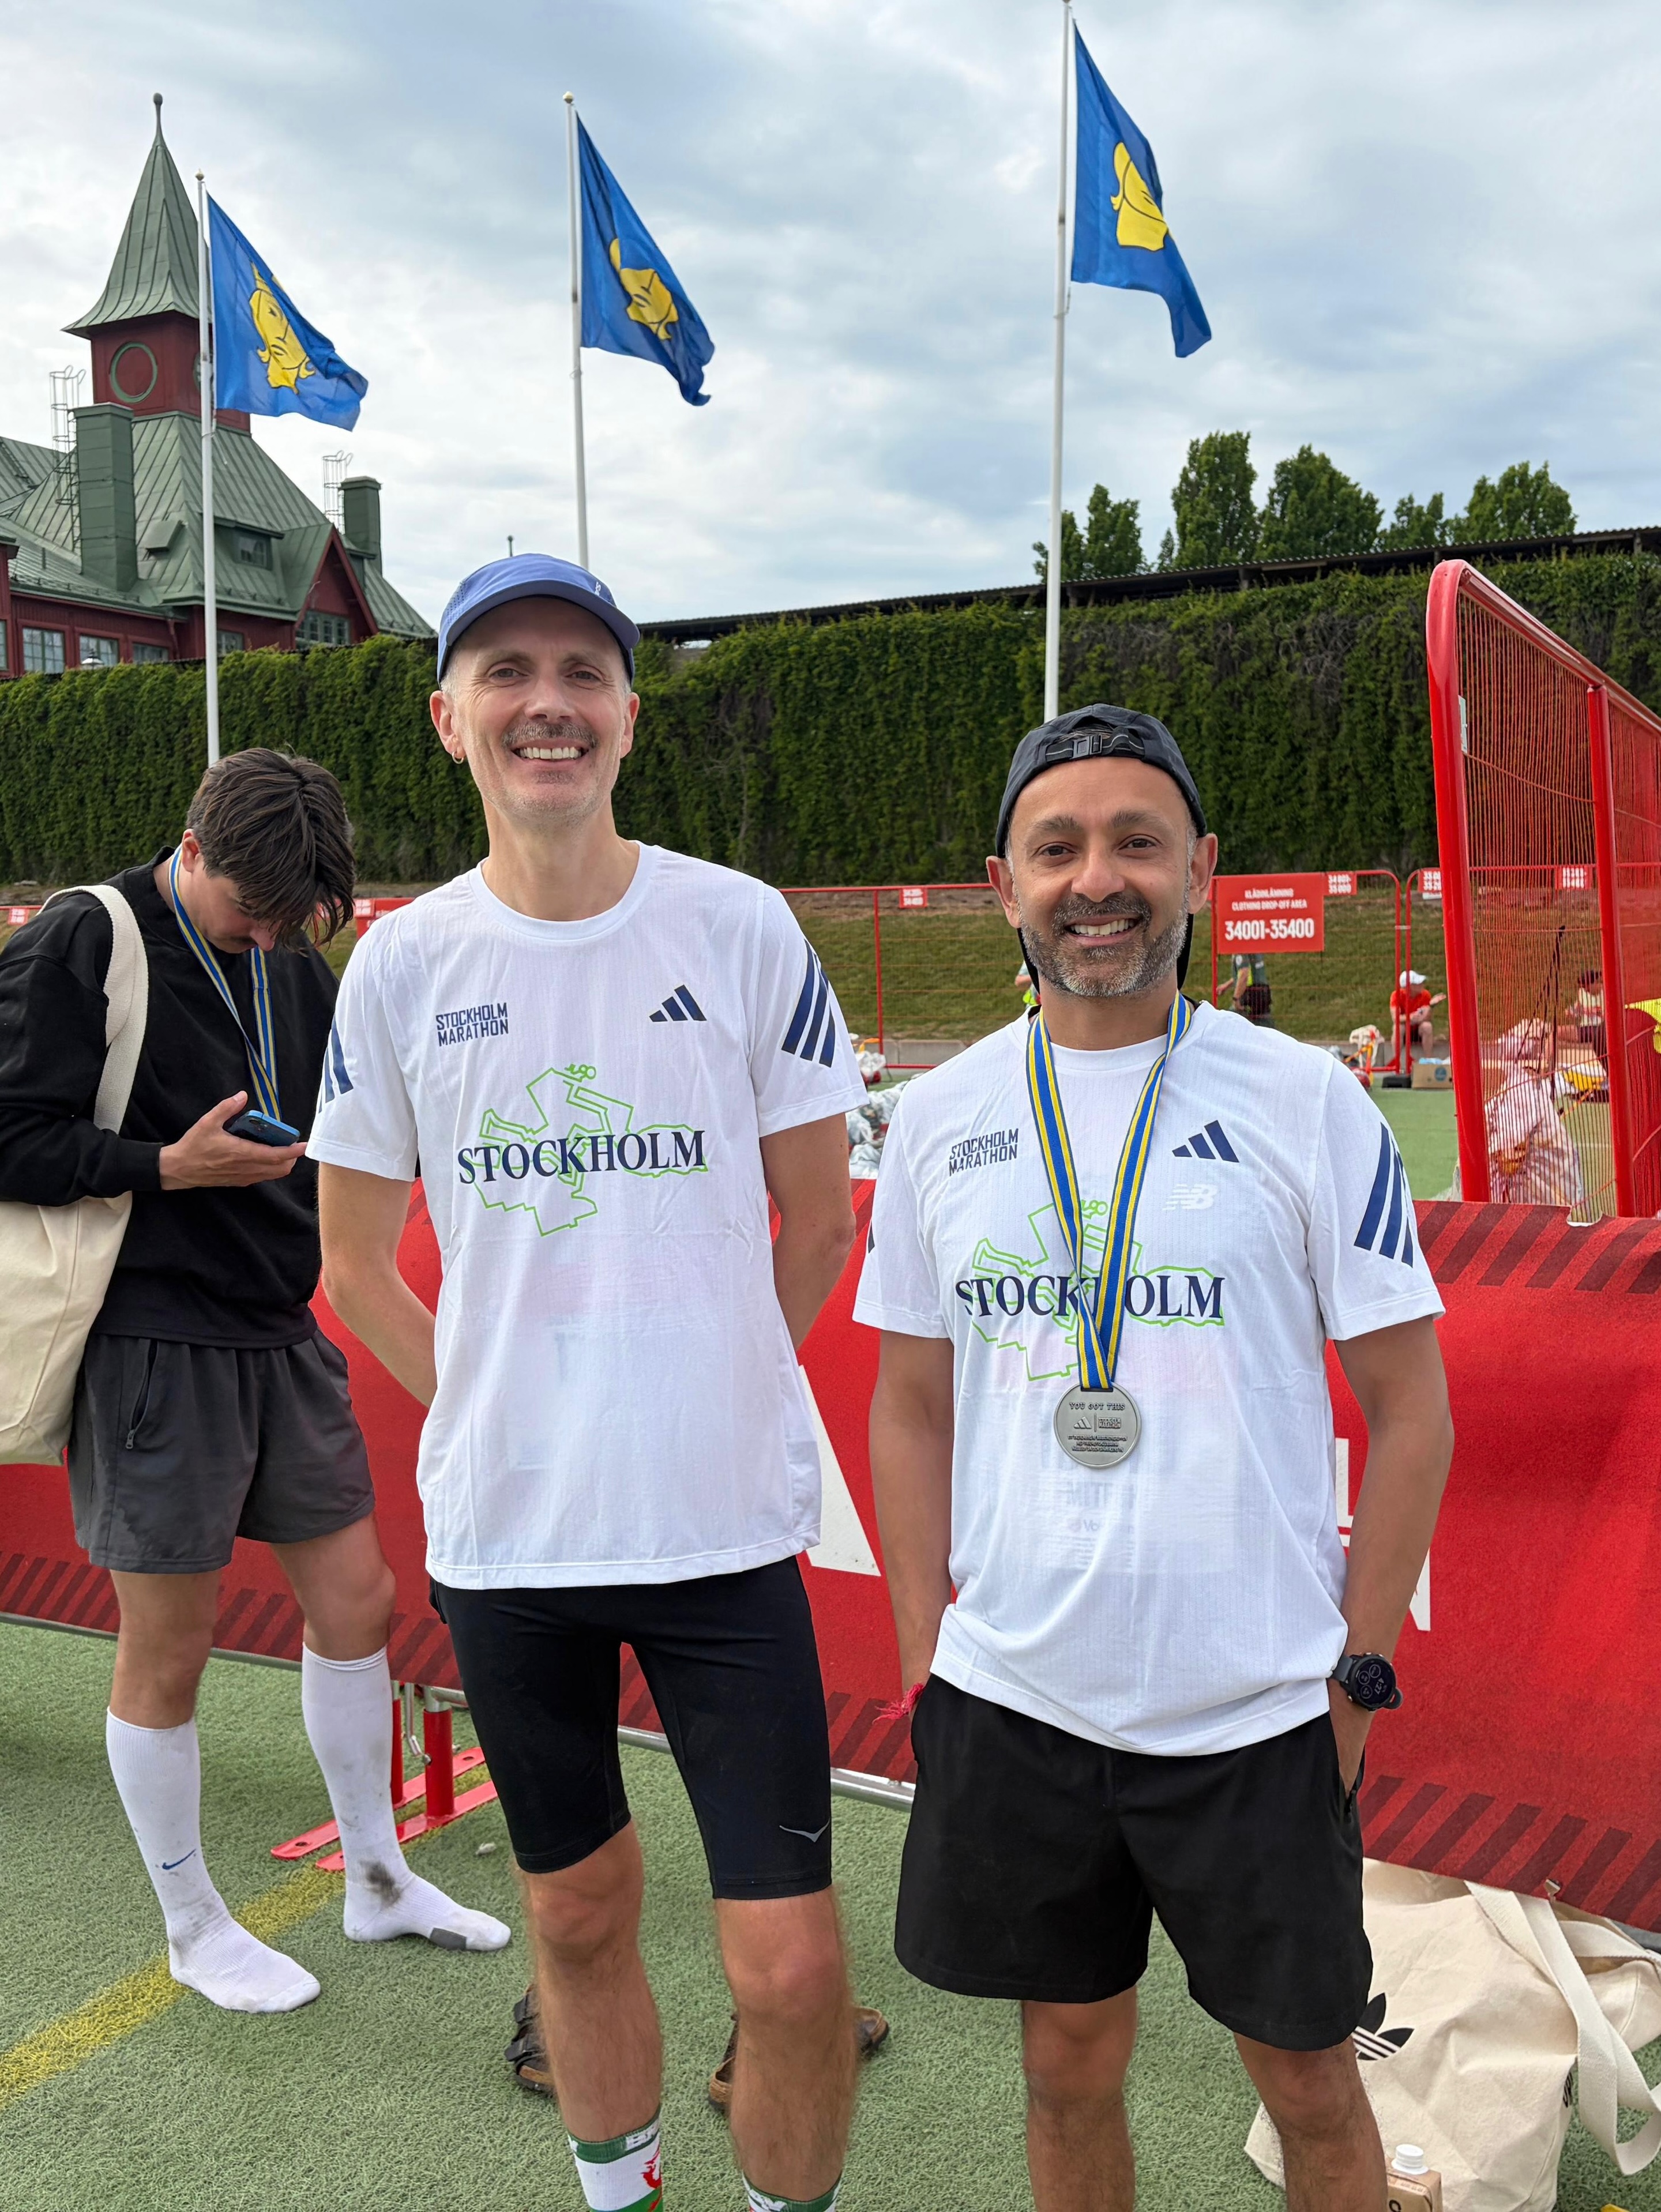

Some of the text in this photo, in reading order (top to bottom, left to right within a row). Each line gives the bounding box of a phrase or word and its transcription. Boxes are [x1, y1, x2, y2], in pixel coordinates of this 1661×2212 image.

[1231, 901, 1261, 911] CLOTHING
[1291, 898, 1307, 909] AREA
[1224, 918, 1315, 941] 34001-35400
[435, 1002, 508, 1030] STOCKHOLM
[438, 1018, 509, 1047] MARATHON
[458, 1130, 706, 1184] STOCKHOLM
[949, 1128, 1019, 1160] STOCKHOLM
[949, 1143, 1017, 1176] MARATHON
[955, 1275, 1225, 1319] STOCKOLM
[1069, 1402, 1126, 1411] YOU GOT THIS
